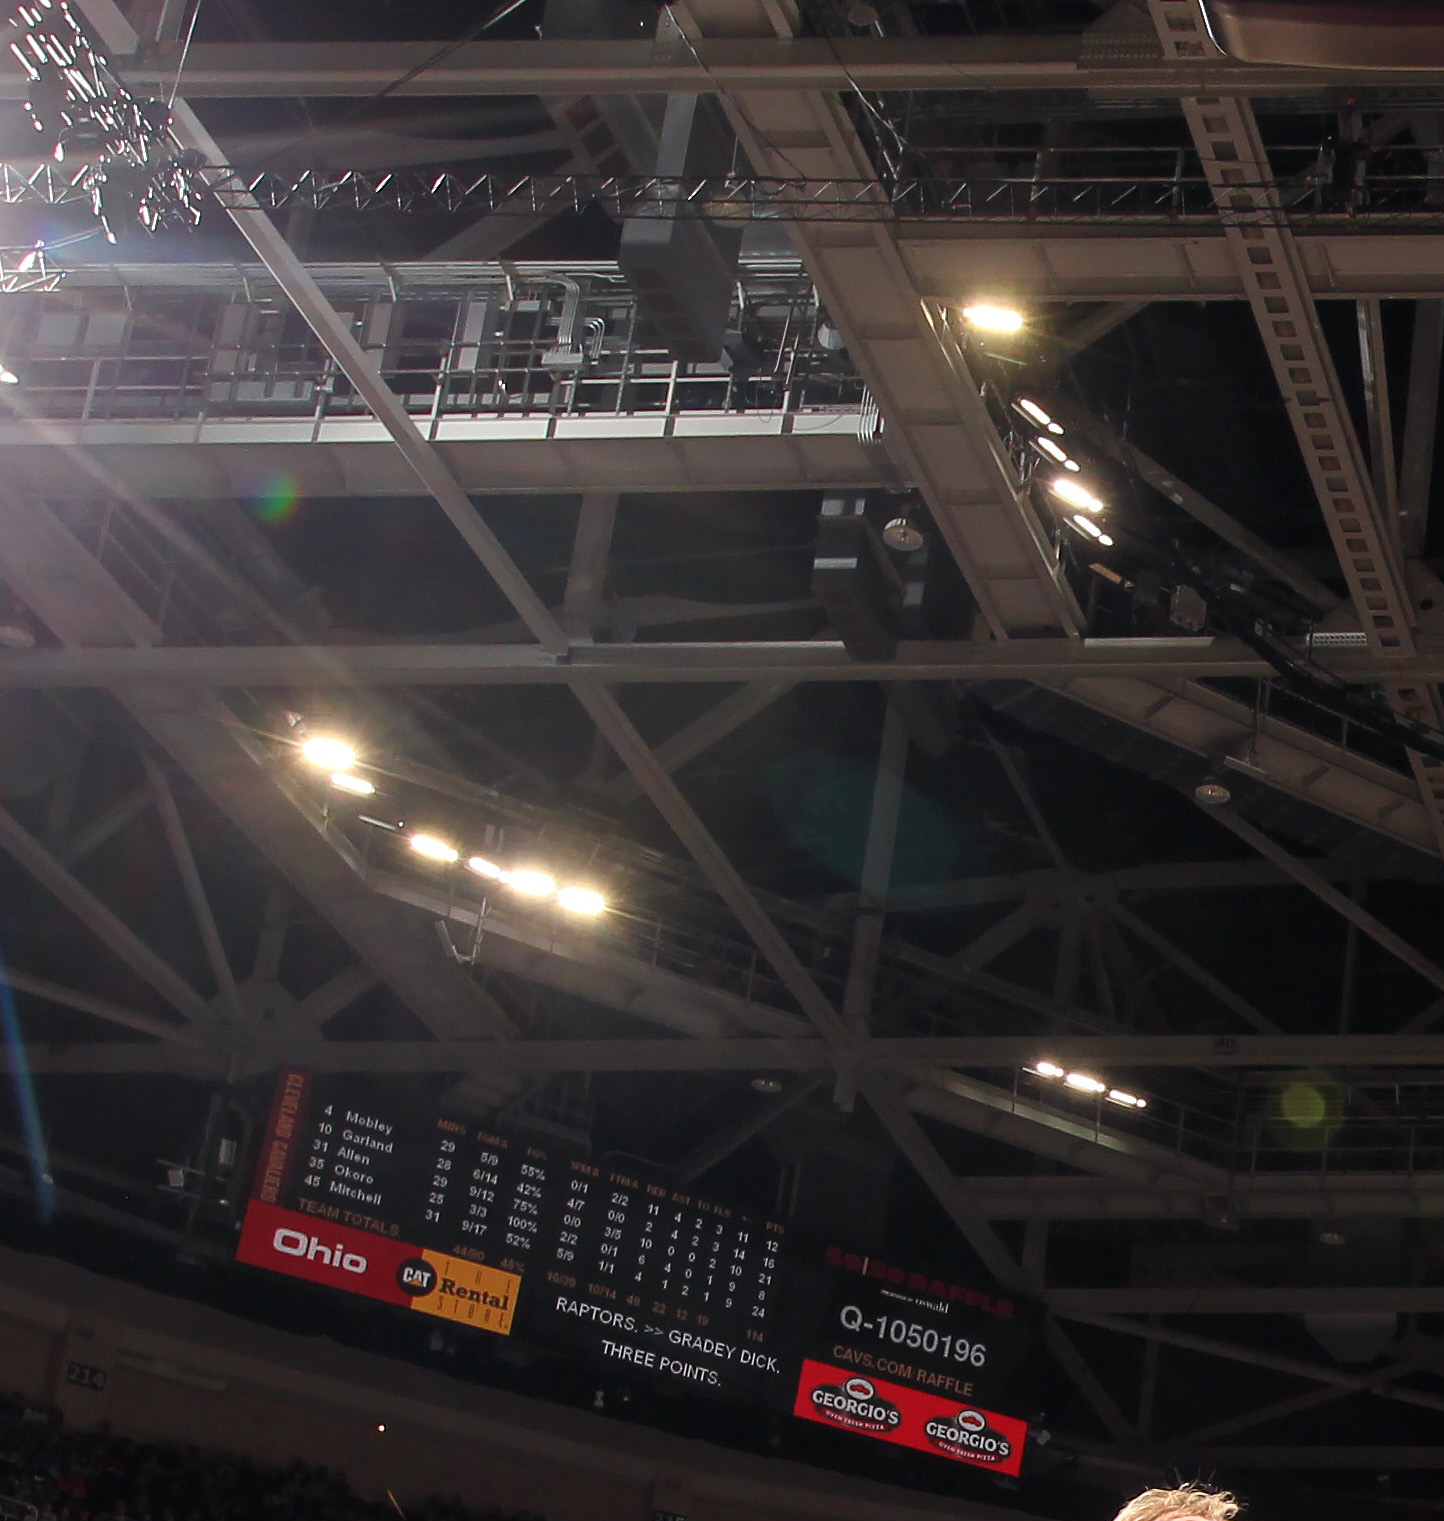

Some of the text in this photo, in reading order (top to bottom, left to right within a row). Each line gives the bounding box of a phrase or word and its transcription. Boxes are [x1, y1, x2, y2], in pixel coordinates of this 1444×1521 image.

[342, 1129, 394, 1154] Garland
[346, 1110, 393, 1136] Mobley
[334, 1165, 375, 1185] Okoro
[337, 1147, 371, 1166] Allen
[330, 1181, 383, 1206] Mitchell
[299, 1197, 401, 1238] TEAM TOTALS
[272, 1227, 369, 1275] Ohio
[402, 1266, 510, 1311] CAT Rental
[556, 1296, 782, 1375] RAPTORS. GRADEY DICK.
[839, 1304, 988, 1368] Q-1050196
[601, 1339, 722, 1387] THREE POINTS.
[811, 1389, 900, 1426] GEORGIO'S
[925, 1421, 1011, 1457] GEORGIO'S
